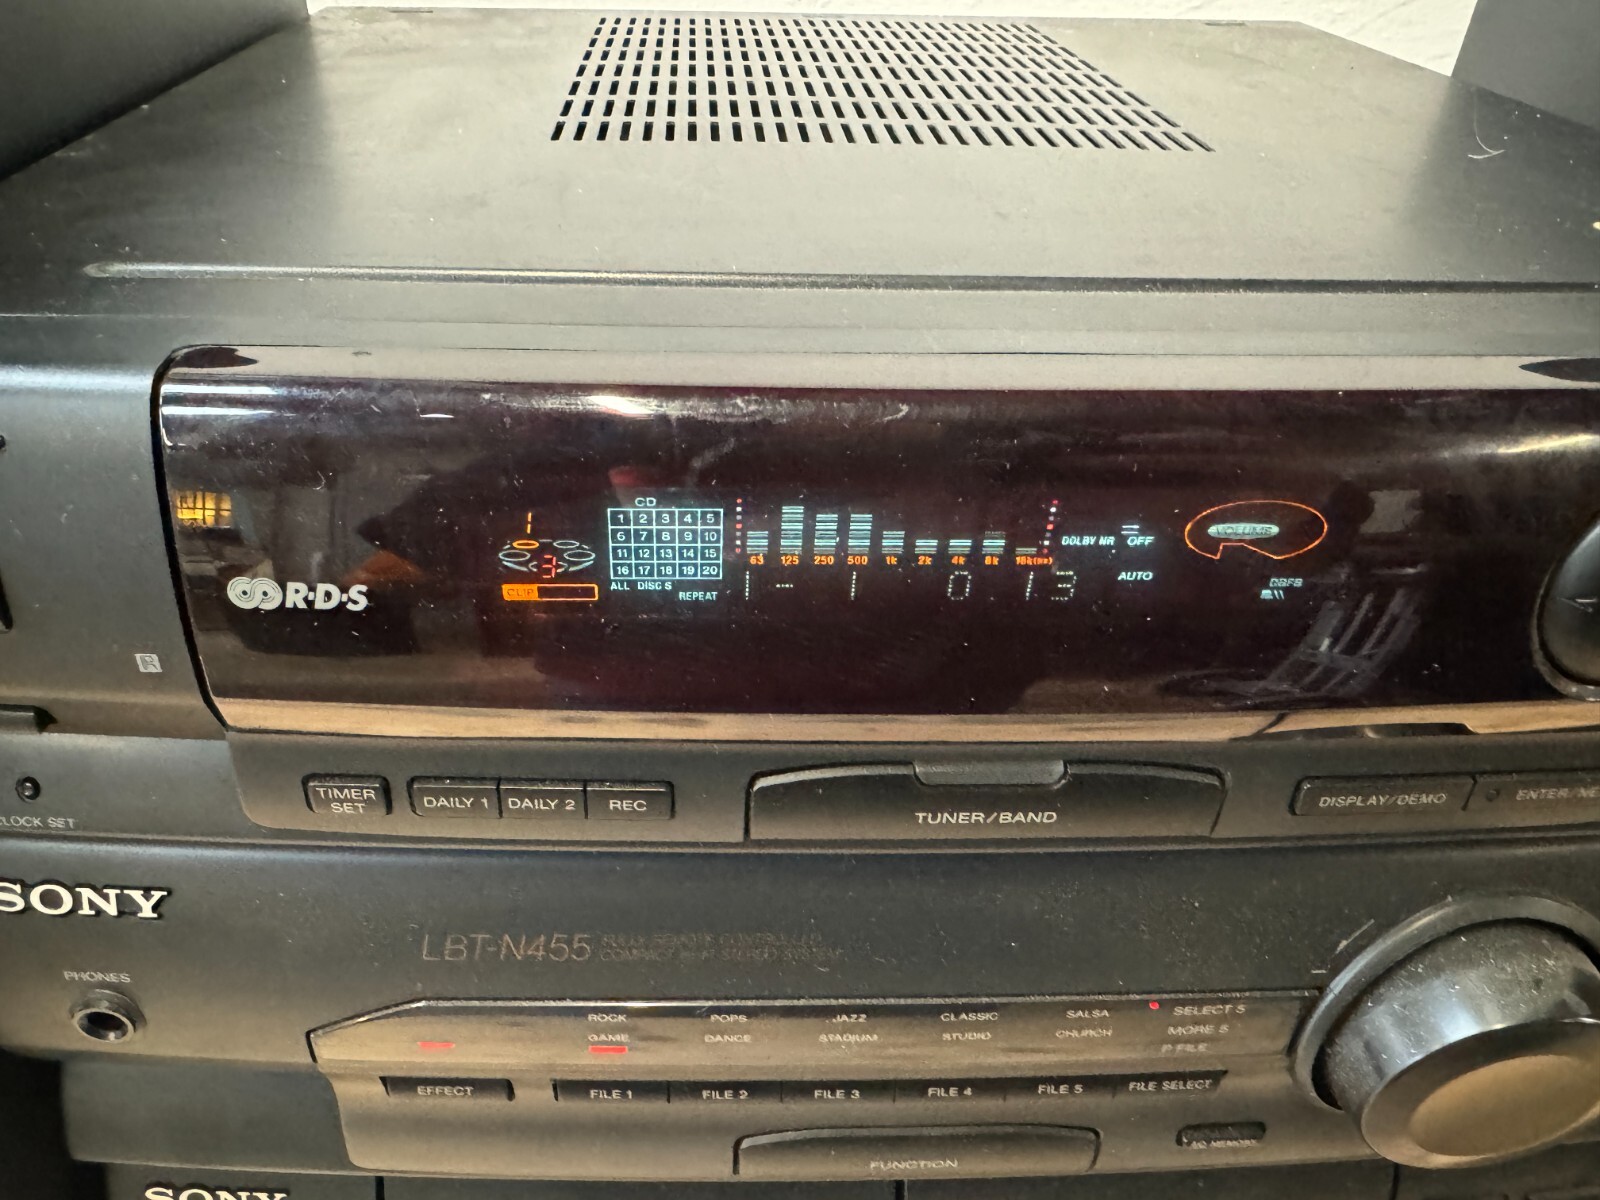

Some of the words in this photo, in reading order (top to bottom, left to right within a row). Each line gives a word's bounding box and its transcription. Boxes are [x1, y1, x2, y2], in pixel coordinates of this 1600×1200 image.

[635, 498, 656, 507] CD
[618, 514, 624, 523] 1
[639, 514, 647, 523] 2
[661, 514, 670, 523] 3
[683, 514, 692, 523] 4
[707, 514, 715, 523] 5
[617, 532, 626, 541] 6
[639, 532, 648, 541] 7
[662, 532, 671, 541] 8
[684, 532, 693, 541] 9
[704, 532, 717, 541] 10
[1061, 536, 1097, 546] DOLBY
[1127, 536, 1155, 546] OFF
[617, 549, 628, 558] 11
[639, 549, 650, 558] 12
[660, 549, 672, 558] 13
[683, 549, 695, 558] 14
[704, 549, 716, 558] 15
[750, 556, 764, 566] 63
[781, 556, 799, 566] 125
[814, 556, 834, 566] 250
[848, 556, 868, 566] 500
[616, 566, 629, 575] 16
[638, 566, 650, 575] 17
[660, 566, 672, 575] 18
[682, 566, 695, 575] 19
[703, 566, 718, 575] 20
[1117, 571, 1154, 581] AUTO
[610, 582, 630, 591] ALL
[507, 588, 534, 597] CLIP
[679, 592, 718, 601] REPEAT
[315, 787, 376, 801] TIMER
[424, 796, 475, 809] DAILY
[480, 797, 488, 809] 1
[508, 797, 557, 810] DAILY
[565, 799, 575, 811] 2
[609, 799, 647, 812] REC
[1319, 793, 1447, 808] DISPLAY/DEMO
[331, 802, 365, 814] SET
[0, 816, 43, 827] LOCK
[47, 816, 76, 829] SET
[915, 811, 1057, 824] TUNER/BAND
[0, 881, 168, 918] SONY
[422, 934, 591, 961] LBT-N455
[63, 970, 131, 983] PHONES
[1066, 1009, 1110, 1019] SALSA
[1173, 1005, 1233, 1016] SELECT
[588, 1013, 627, 1022] ROCK
[710, 1014, 748, 1023] POPS
[832, 1013, 867, 1022] JAZZ
[940, 1012, 999, 1022] CLASSIC
[588, 1033, 630, 1043] GAME
[704, 1034, 752, 1043] DANCE
[942, 1031, 992, 1041] STUDIO
[1038, 1084, 1070, 1095] FILE
[1129, 1081, 1158, 1091] FILE
[1162, 1079, 1212, 1091] SELECT
[417, 1086, 474, 1096] EFFECT
[590, 1089, 624, 1099] FILE
[702, 1089, 735, 1099] FILE
[737, 1089, 749, 1100] 2
[814, 1089, 847, 1099] FILE
[850, 1089, 861, 1099] 3
[927, 1087, 959, 1098] FILE
[963, 1086, 973, 1097] 4
[870, 1158, 959, 1171] FUNCTION
